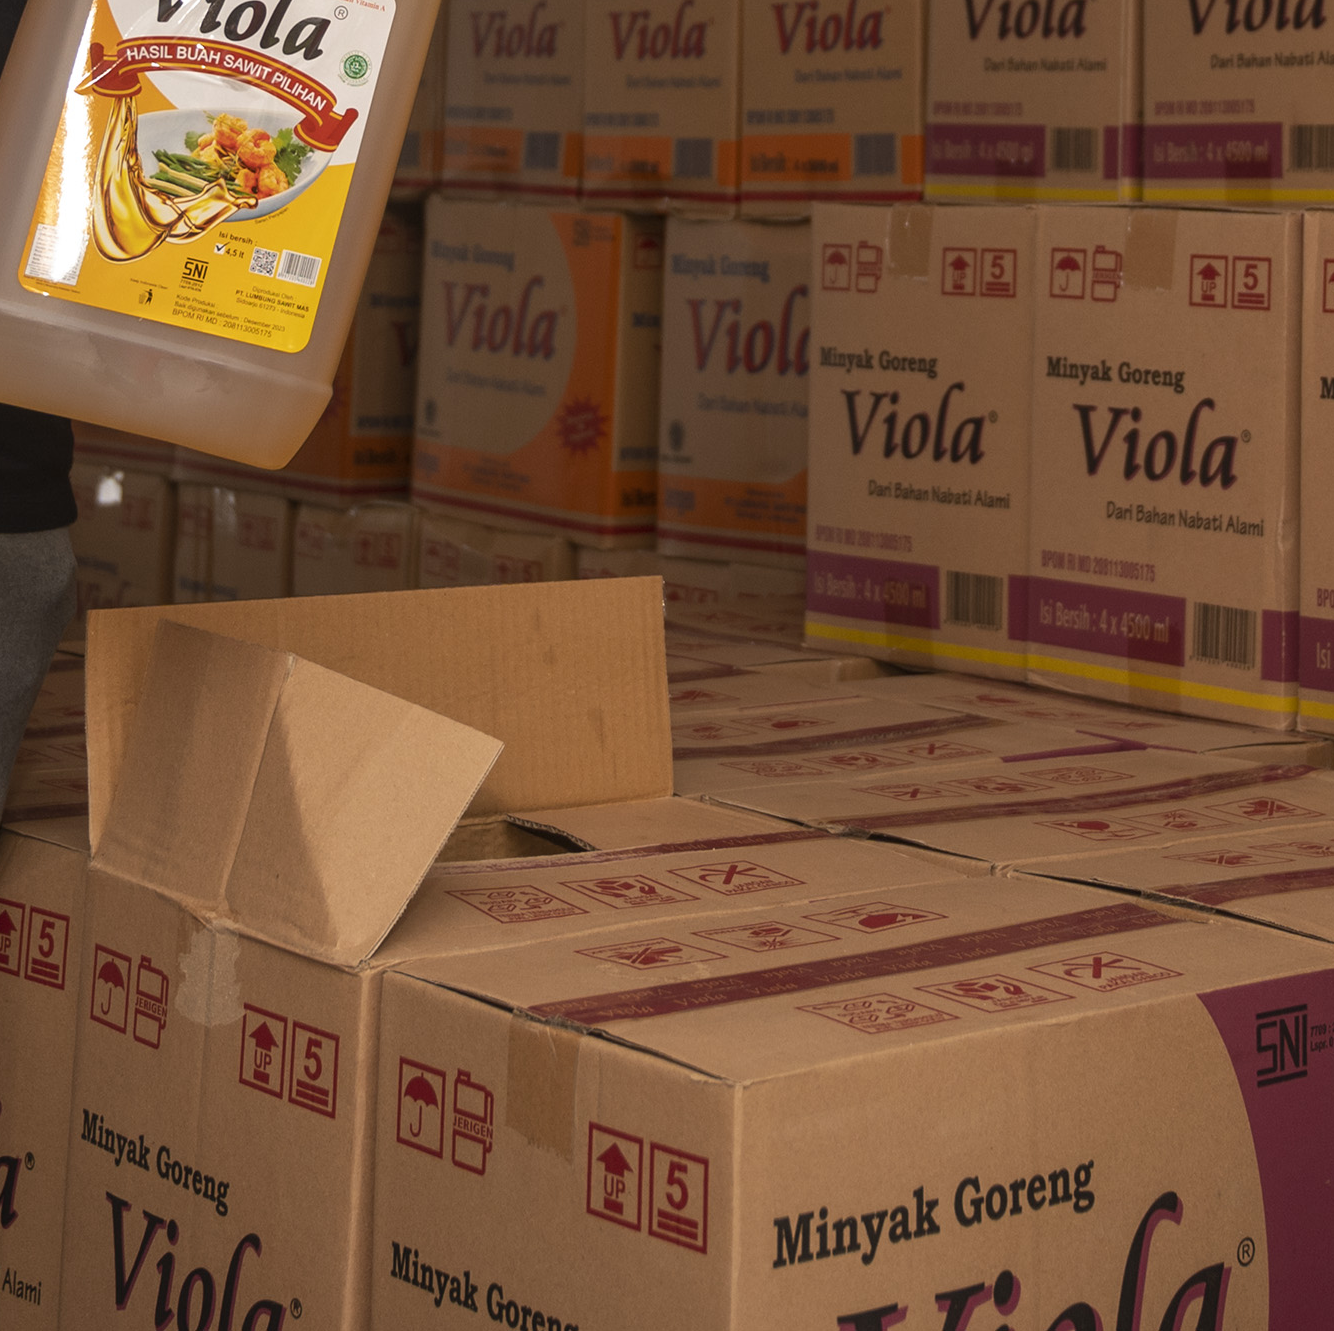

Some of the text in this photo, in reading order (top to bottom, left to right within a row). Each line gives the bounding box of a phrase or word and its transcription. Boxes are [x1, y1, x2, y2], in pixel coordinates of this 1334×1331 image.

[126, 43, 327, 111] HASIL BUAH SAWIT PILIHAN
[219, 231, 253, 245] Isi bersih
[225, 248, 238, 257] 4,5
[182, 261, 208, 279] SNI
[172, 309, 195, 319] BPOM
[206, 316, 218, 325] MD
[246, 292, 276, 304] LUMBUNG
[277, 299, 296, 309] SAWIT
[297, 304, 310, 312] MAS
[840, 382, 987, 467] Viola
[1073, 398, 1239, 490] Viola
[1314, 641, 1332, 670] Isi
[38, 919, 55, 958] 5
[253, 1047, 273, 1069] UP
[303, 1036, 323, 1081] 5
[1256, 1014, 1307, 1076] SNI
[452, 1114, 495, 1142] JERIGEN
[81, 1108, 230, 1217] Minyak Goreng
[665, 1161, 691, 1211] 5
[772, 1186, 941, 1270] Minyak
[952, 1160, 1096, 1228] Goreng
[390, 1240, 582, 1331] Minyak Goreng
